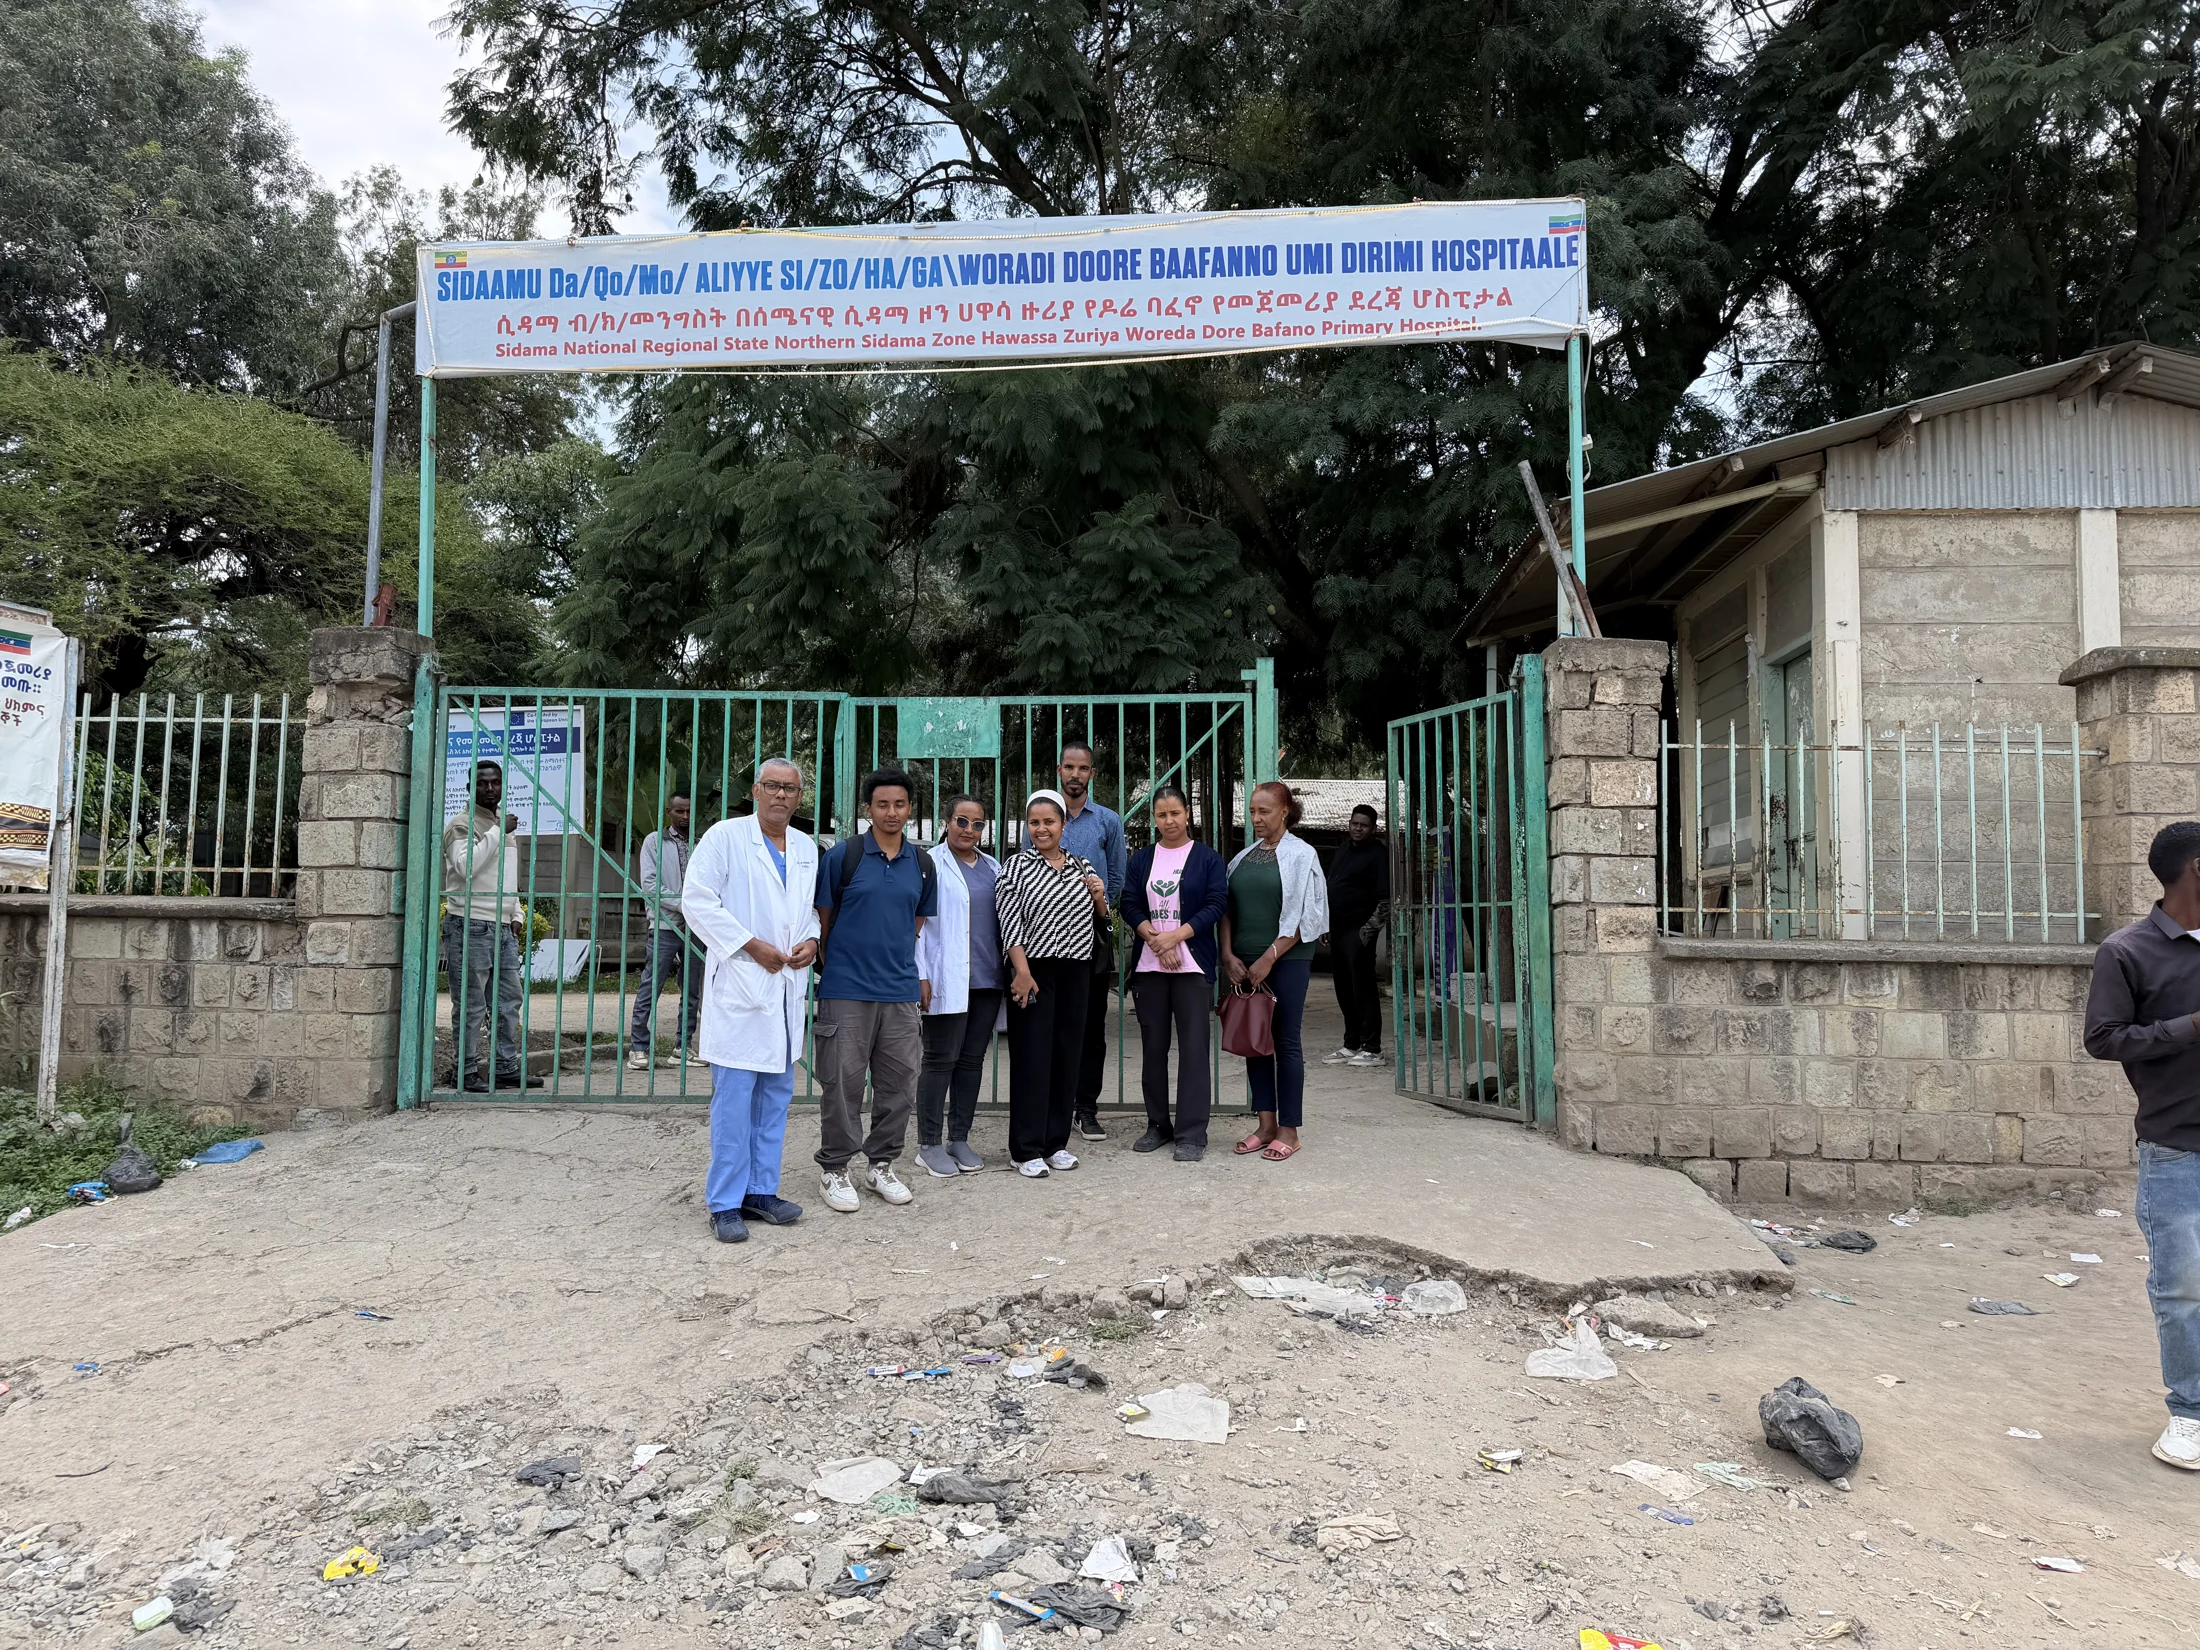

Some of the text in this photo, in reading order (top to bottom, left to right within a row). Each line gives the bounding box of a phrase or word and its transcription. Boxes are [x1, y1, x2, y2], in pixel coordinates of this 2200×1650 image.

[437, 268, 542, 302] SIDAAMU
[549, 262, 688, 302] Da/Qo/Mo/
[696, 260, 773, 293] ALIYYE
[1063, 248, 1142, 283] DOORE
[1150, 244, 1277, 280] BAAFANNO
[1286, 243, 1332, 275] UMI
[1341, 240, 1423, 273] DIRIMI
[1432, 235, 1579, 272] HOSPITAALE
[497, 286, 1513, 336] ሲዳማ ብ/ክ/መንግስት በሰሜናዊ ሲዳማ ዞን ሀዋሳ ዙሪያ የዶሬ ባፈኖ የመጀመሪያ ደረጃ ሆስፒታል
[496, 343, 558, 357] Sidama
[563, 339, 637, 355] National
[643, 337, 719, 357] Regional
[724, 336, 769, 351] State
[775, 335, 856, 349] Northern
[862, 333, 926, 348] Sidama
[932, 332, 976, 346] Zone
[982, 331, 1057, 345] Hawassa
[1063, 329, 1120, 346] Zuriya
[1126, 325, 1196, 341] Woreda
[1202, 324, 1246, 339] Dore
[1252, 322, 1315, 337] Bafano
[1321, 319, 1394, 335] Primary
